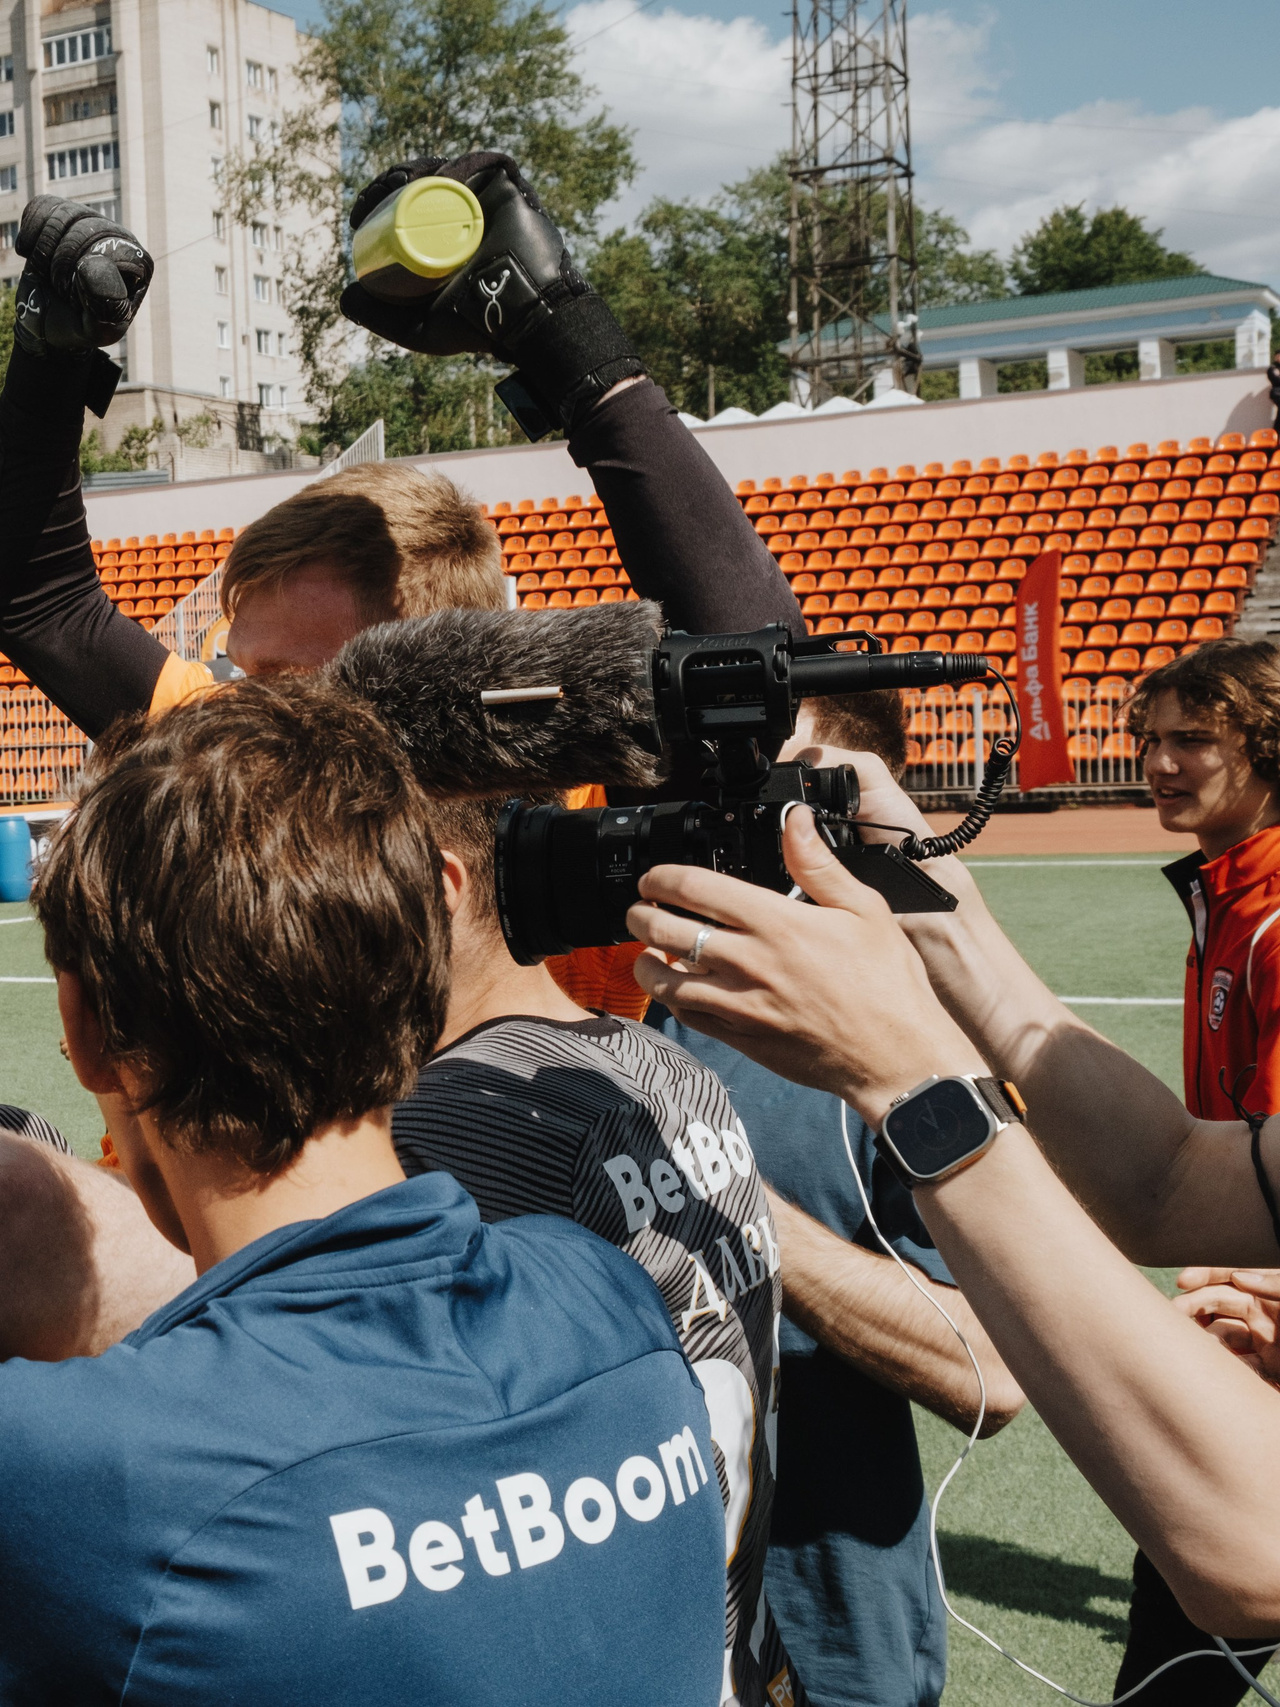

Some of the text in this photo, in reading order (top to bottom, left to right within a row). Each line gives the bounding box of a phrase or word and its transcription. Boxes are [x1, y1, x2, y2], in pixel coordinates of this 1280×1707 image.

[741, 690, 817, 701] SENSER
[1021, 601, 1049, 740] Альфа Банк
[329, 1424, 709, 1610] BetBoom
